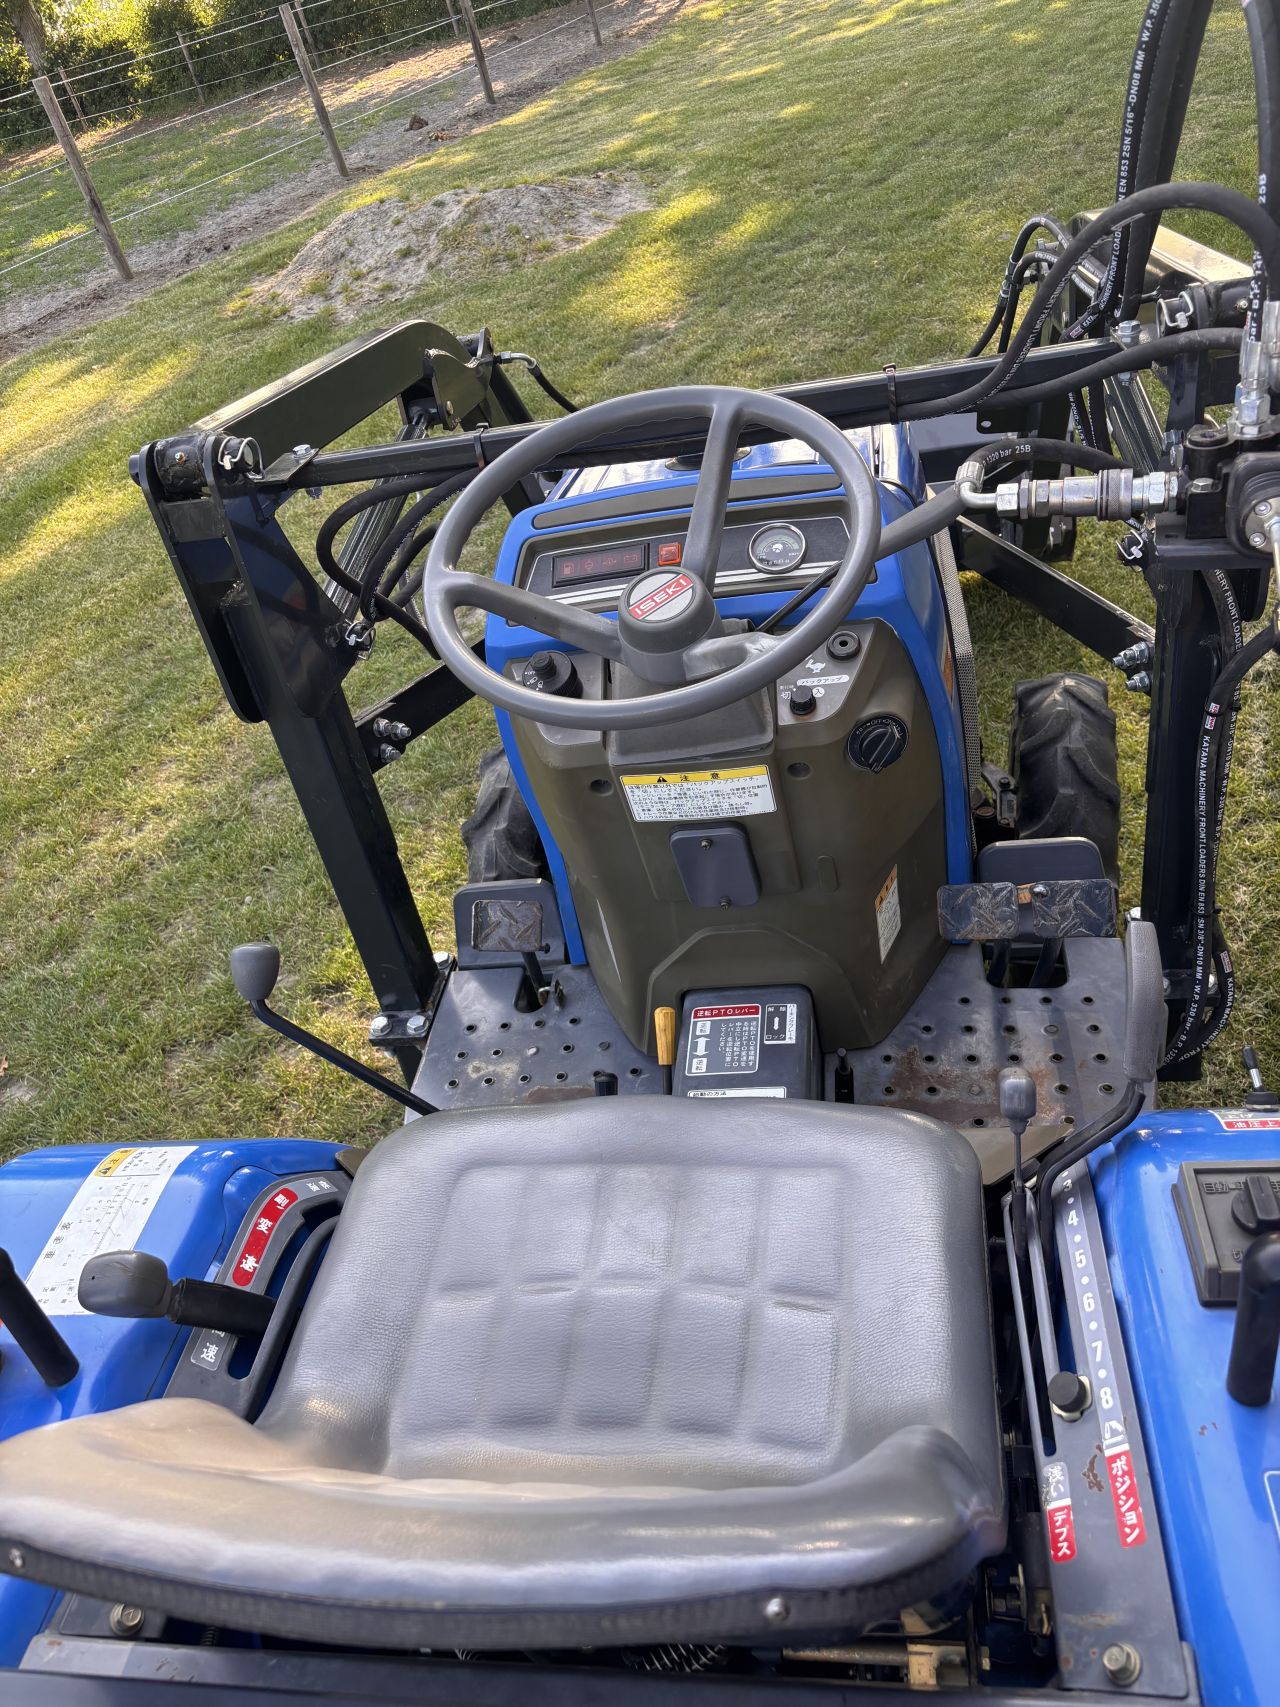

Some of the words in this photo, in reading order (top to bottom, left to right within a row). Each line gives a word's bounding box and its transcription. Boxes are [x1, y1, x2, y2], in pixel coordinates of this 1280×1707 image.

[1134, 50, 1146, 71] MM
[1122, 137, 1132, 158] 2SN
[1120, 159, 1130, 177] 853
[1119, 178, 1128, 193] EN
[999, 448, 1012, 458] bar
[1015, 444, 1032, 455] 25B
[634, 579, 687, 615] ISEKI
[1224, 590, 1239, 620] FRONT
[1200, 735, 1211, 768] KATANA
[680, 772, 721, 782] 注意
[1198, 770, 1207, 816] MACHINERY
[1199, 817, 1207, 844] FRONT
[1198, 844, 1207, 878] LOADERS
[1198, 879, 1206, 891] DIN
[1198, 891, 1205, 902] EN
[1195, 966, 1203, 979] MM
[1226, 976, 1235, 1007] KATANA
[1189, 1002, 1198, 1017] 330
[1184, 1017, 1194, 1031] bar
[1063, 1178, 1073, 1192] 3
[1067, 1210, 1079, 1226] 4
[1075, 1250, 1087, 1269] 5
[1082, 1292, 1095, 1312] 6
[1091, 1341, 1104, 1362] 7
[1099, 1386, 1114, 1410] 8
[1048, 1465, 1065, 1498] 浅い
[1111, 1455, 1140, 1544] ポジション
